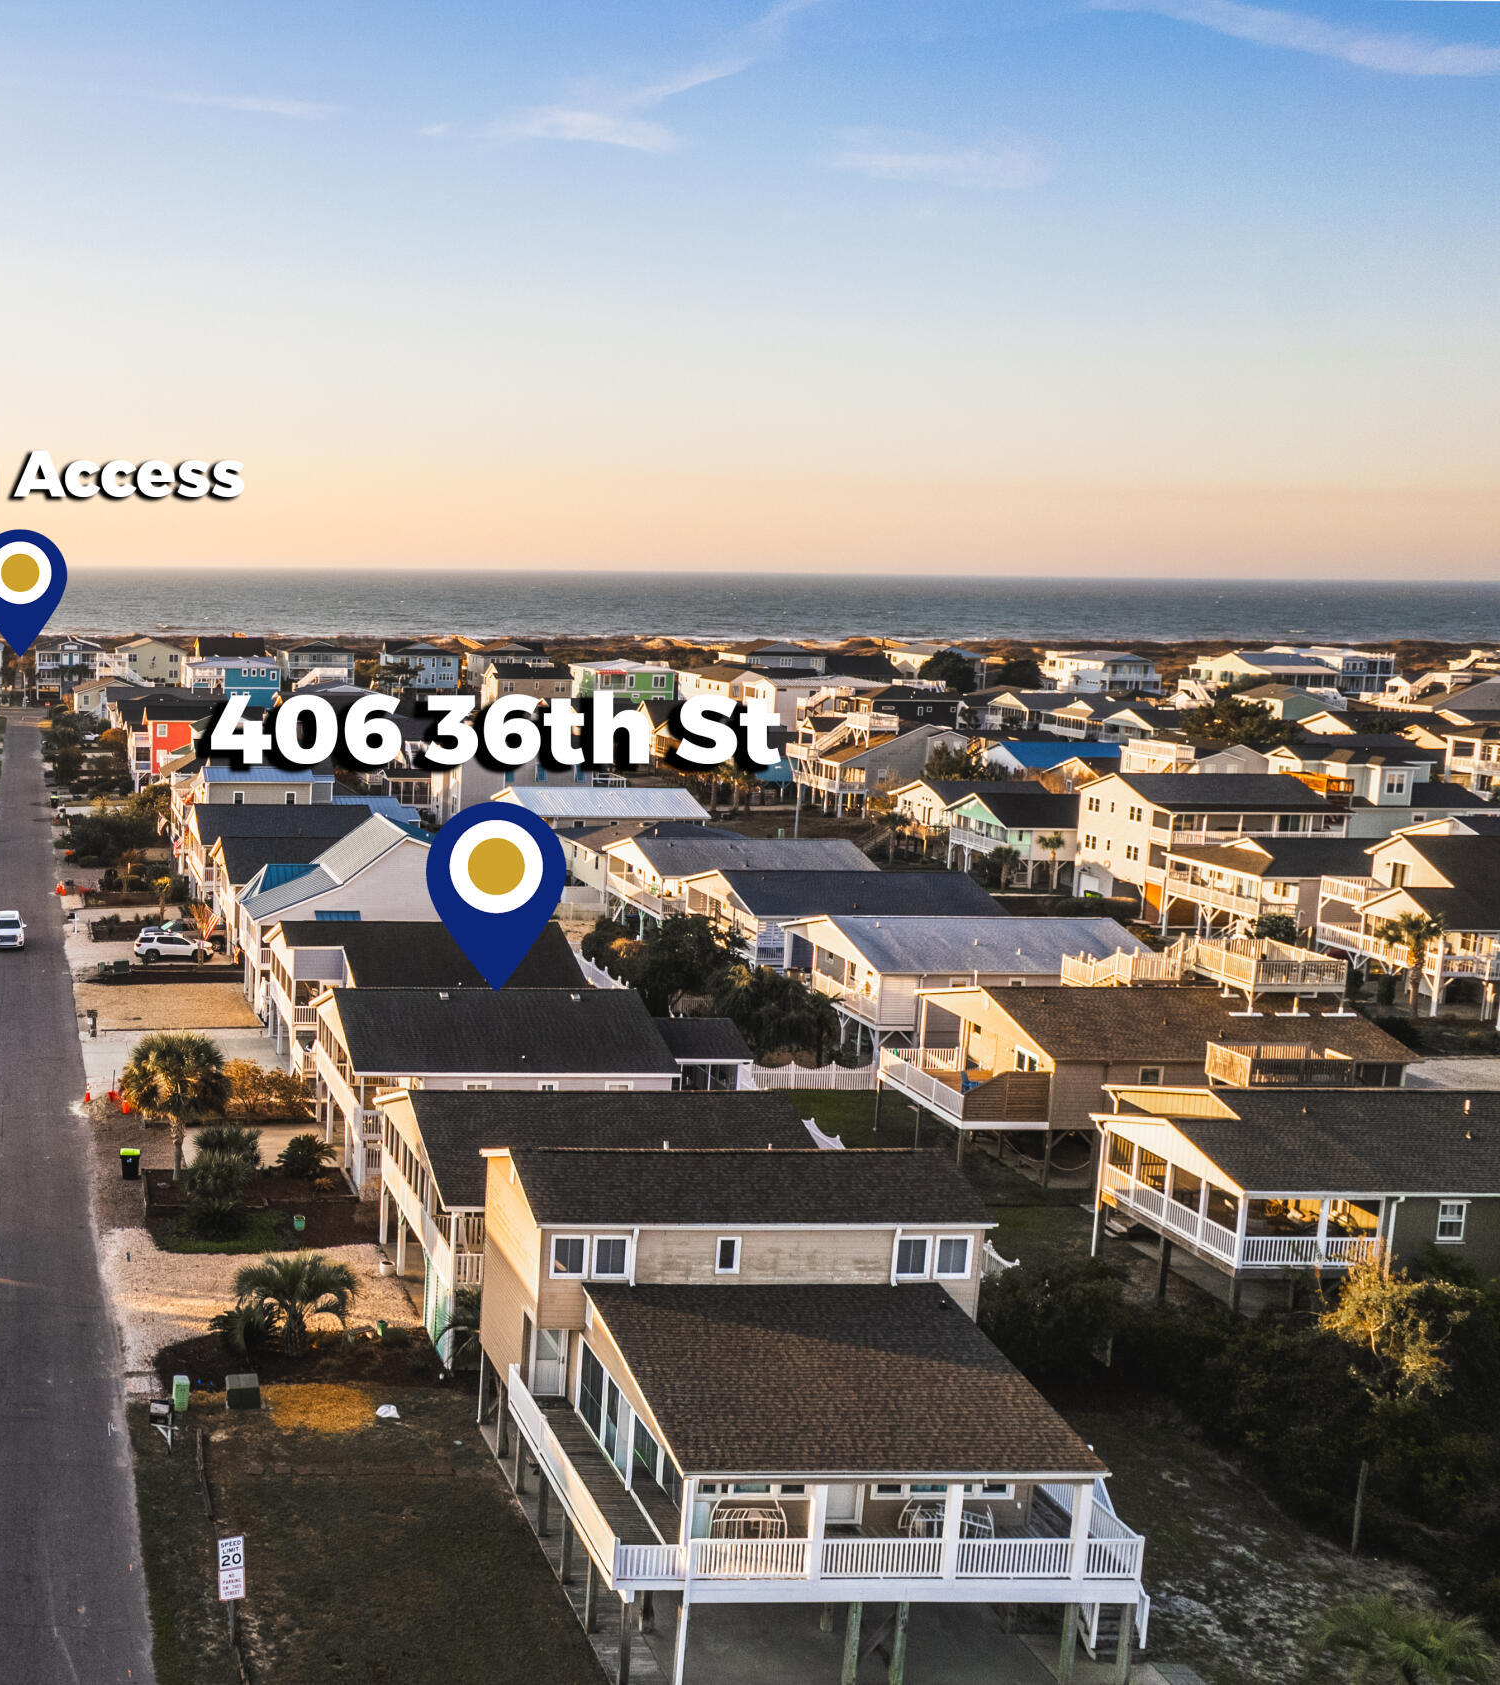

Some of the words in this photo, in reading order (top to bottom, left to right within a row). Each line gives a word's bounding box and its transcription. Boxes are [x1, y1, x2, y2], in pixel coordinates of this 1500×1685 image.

[220, 1540, 242, 1548] SPEED
[222, 1546, 239, 1554] LIMIT
[221, 1553, 242, 1566] 20
